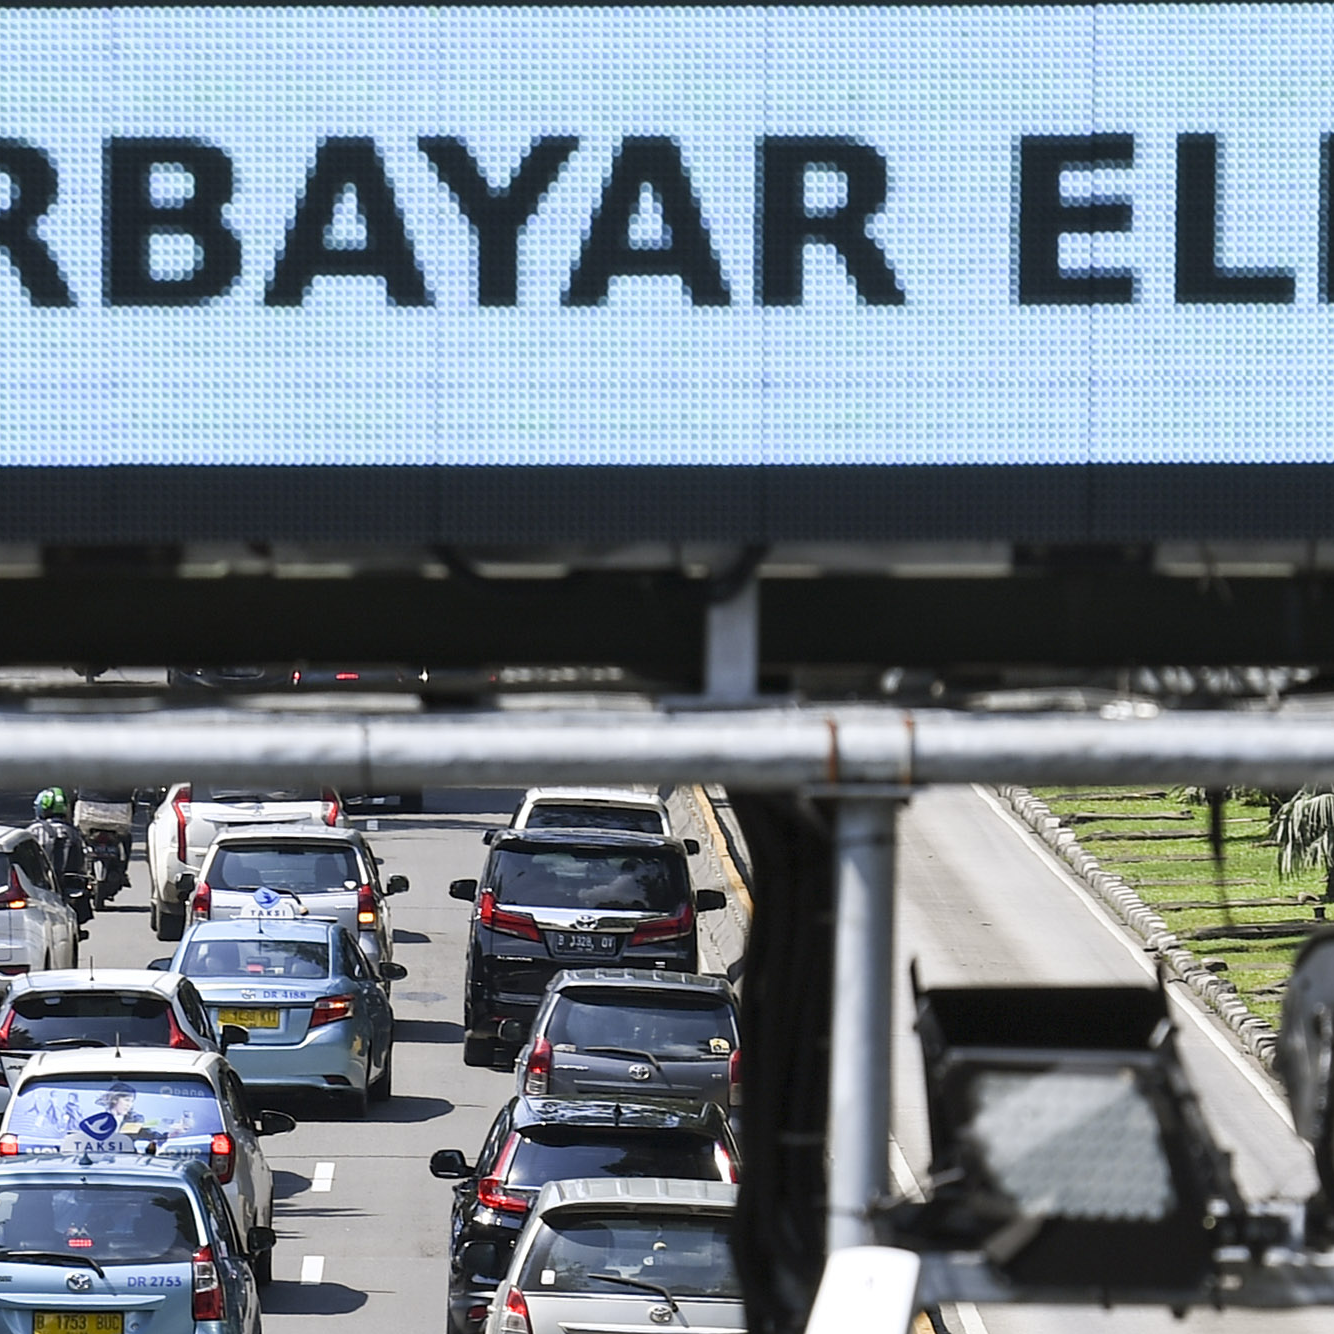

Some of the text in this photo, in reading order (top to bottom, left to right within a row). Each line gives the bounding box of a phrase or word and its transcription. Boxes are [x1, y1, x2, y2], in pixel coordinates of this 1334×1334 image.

[251, 909, 286, 917] TAKSI
[263, 990, 278, 999] DR
[74, 1141, 123, 1151] TAKSI
[127, 1276, 182, 1287] DR 2753
[36, 1315, 45, 1330] B
[56, 1315, 87, 1330] 1753
